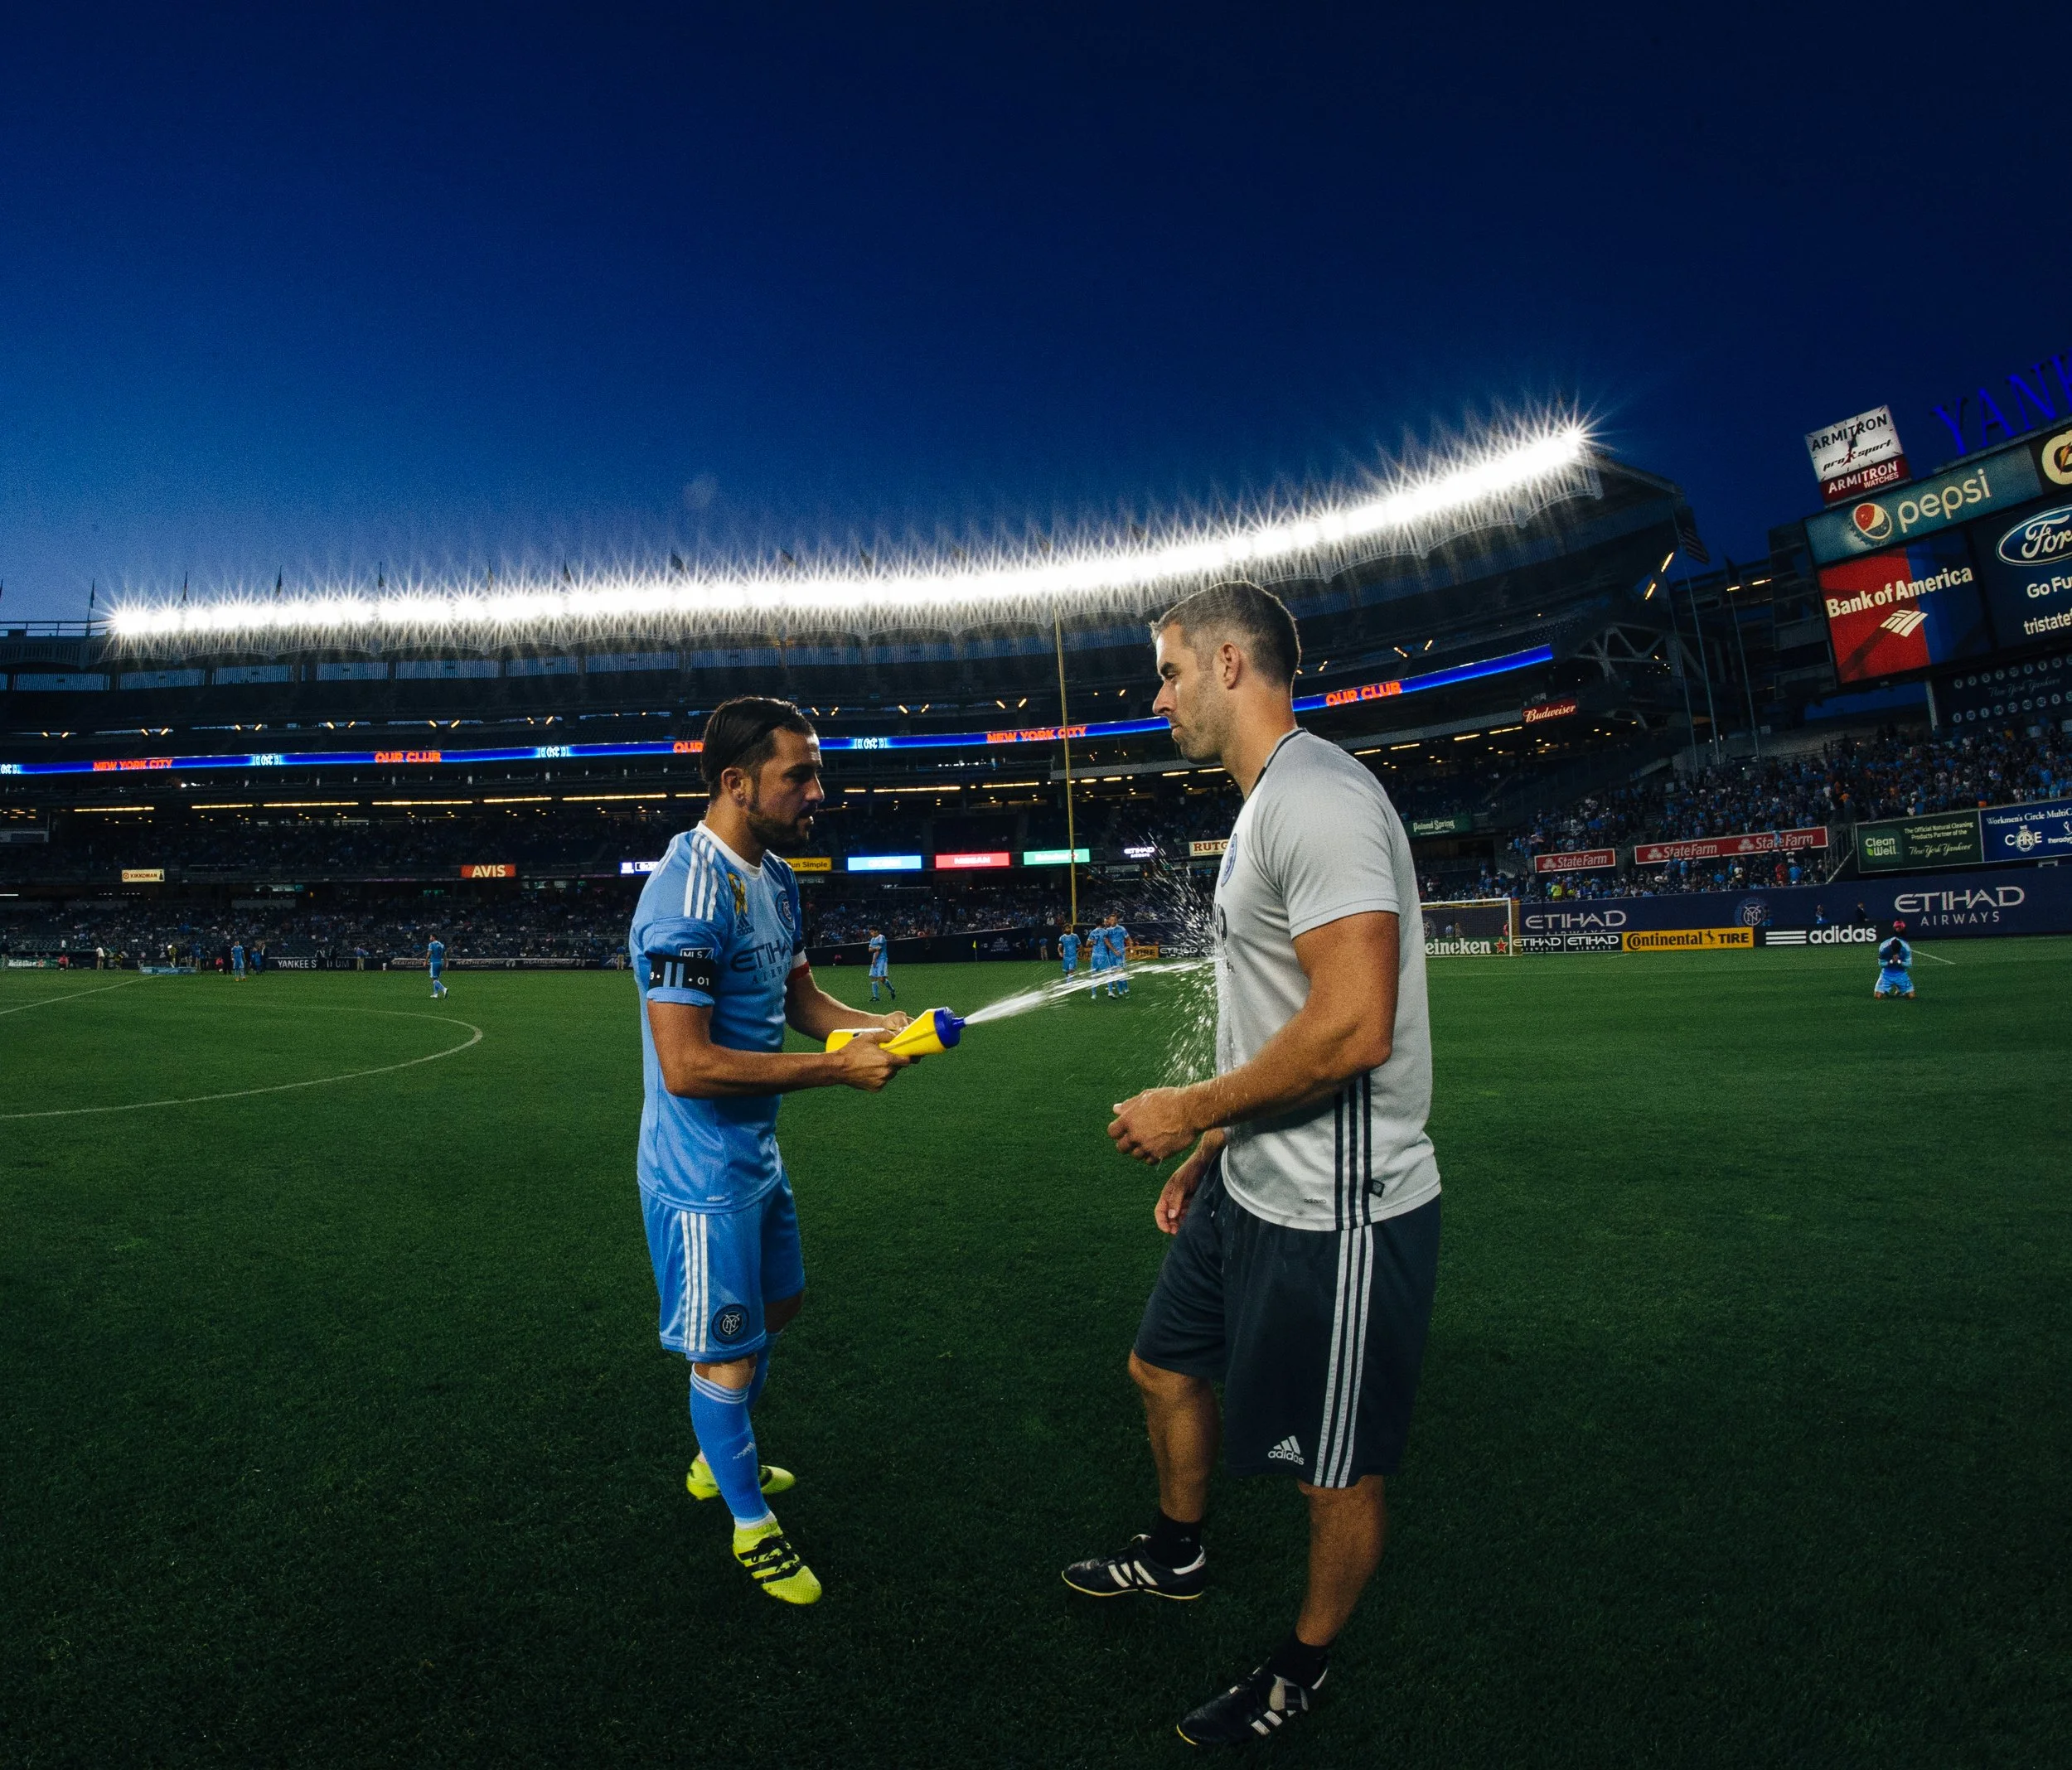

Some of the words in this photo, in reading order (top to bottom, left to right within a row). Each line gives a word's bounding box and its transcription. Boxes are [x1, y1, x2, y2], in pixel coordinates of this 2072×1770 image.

[1812, 413, 1887, 452] ARMITRON
[1828, 461, 1898, 494] ARMITRON
[1863, 472, 1899, 489] WATCHES
[1897, 468, 1991, 533] pepsi
[1826, 589, 1874, 618] Bank
[1874, 583, 1893, 606] of
[1895, 568, 1973, 602] America
[2026, 583, 2050, 598] Go
[1326, 689, 1358, 707] OUR
[1360, 681, 1402, 700] CLUB
[1523, 704, 1576, 723] Budweiser
[986, 731, 1017, 744] NEW
[1019, 729, 1055, 742] YORK
[1057, 726, 1087, 738] CTY
[673, 742, 704, 753] OUR
[93, 762, 118, 771] NEW
[119, 760, 148, 771] YORK
[148, 758, 173, 769] CITY
[375, 752, 404, 763] OUR
[405, 752, 441, 762] CLUB
[1986, 814, 2023, 825] Workmen's
[2024, 811, 2045, 821] Circle
[1413, 820, 1434, 833] Poland
[1434, 820, 1455, 830] Spring
[1914, 825, 1932, 834] Official
[1951, 821, 1974, 829] Cleaning
[1865, 837, 1895, 847] Clean
[1873, 845, 1896, 856] Well
[1909, 845, 1924, 856] New
[1924, 844, 1940, 858] York
[1940, 842, 1973, 857] Yankees
[472, 864, 506, 878] AVIS
[802, 861, 828, 869] Simple
[1894, 886, 2025, 913] ETIHAD
[1525, 910, 1626, 930] ETIHAD
[1920, 911, 2000, 926] AIRWAYS
[1513, 937, 1562, 947] ETIHAD
[1566, 936, 1619, 945] ETIHAD
[1627, 930, 1702, 950] Continental
[1719, 932, 1749, 945] TIRE
[1809, 925, 1876, 945] adidas
[1425, 937, 1491, 955] eineken
[278, 960, 309, 969] YANKEE
[697, 976, 709, 986] 01
[1267, 1448, 1305, 1465] adidas
